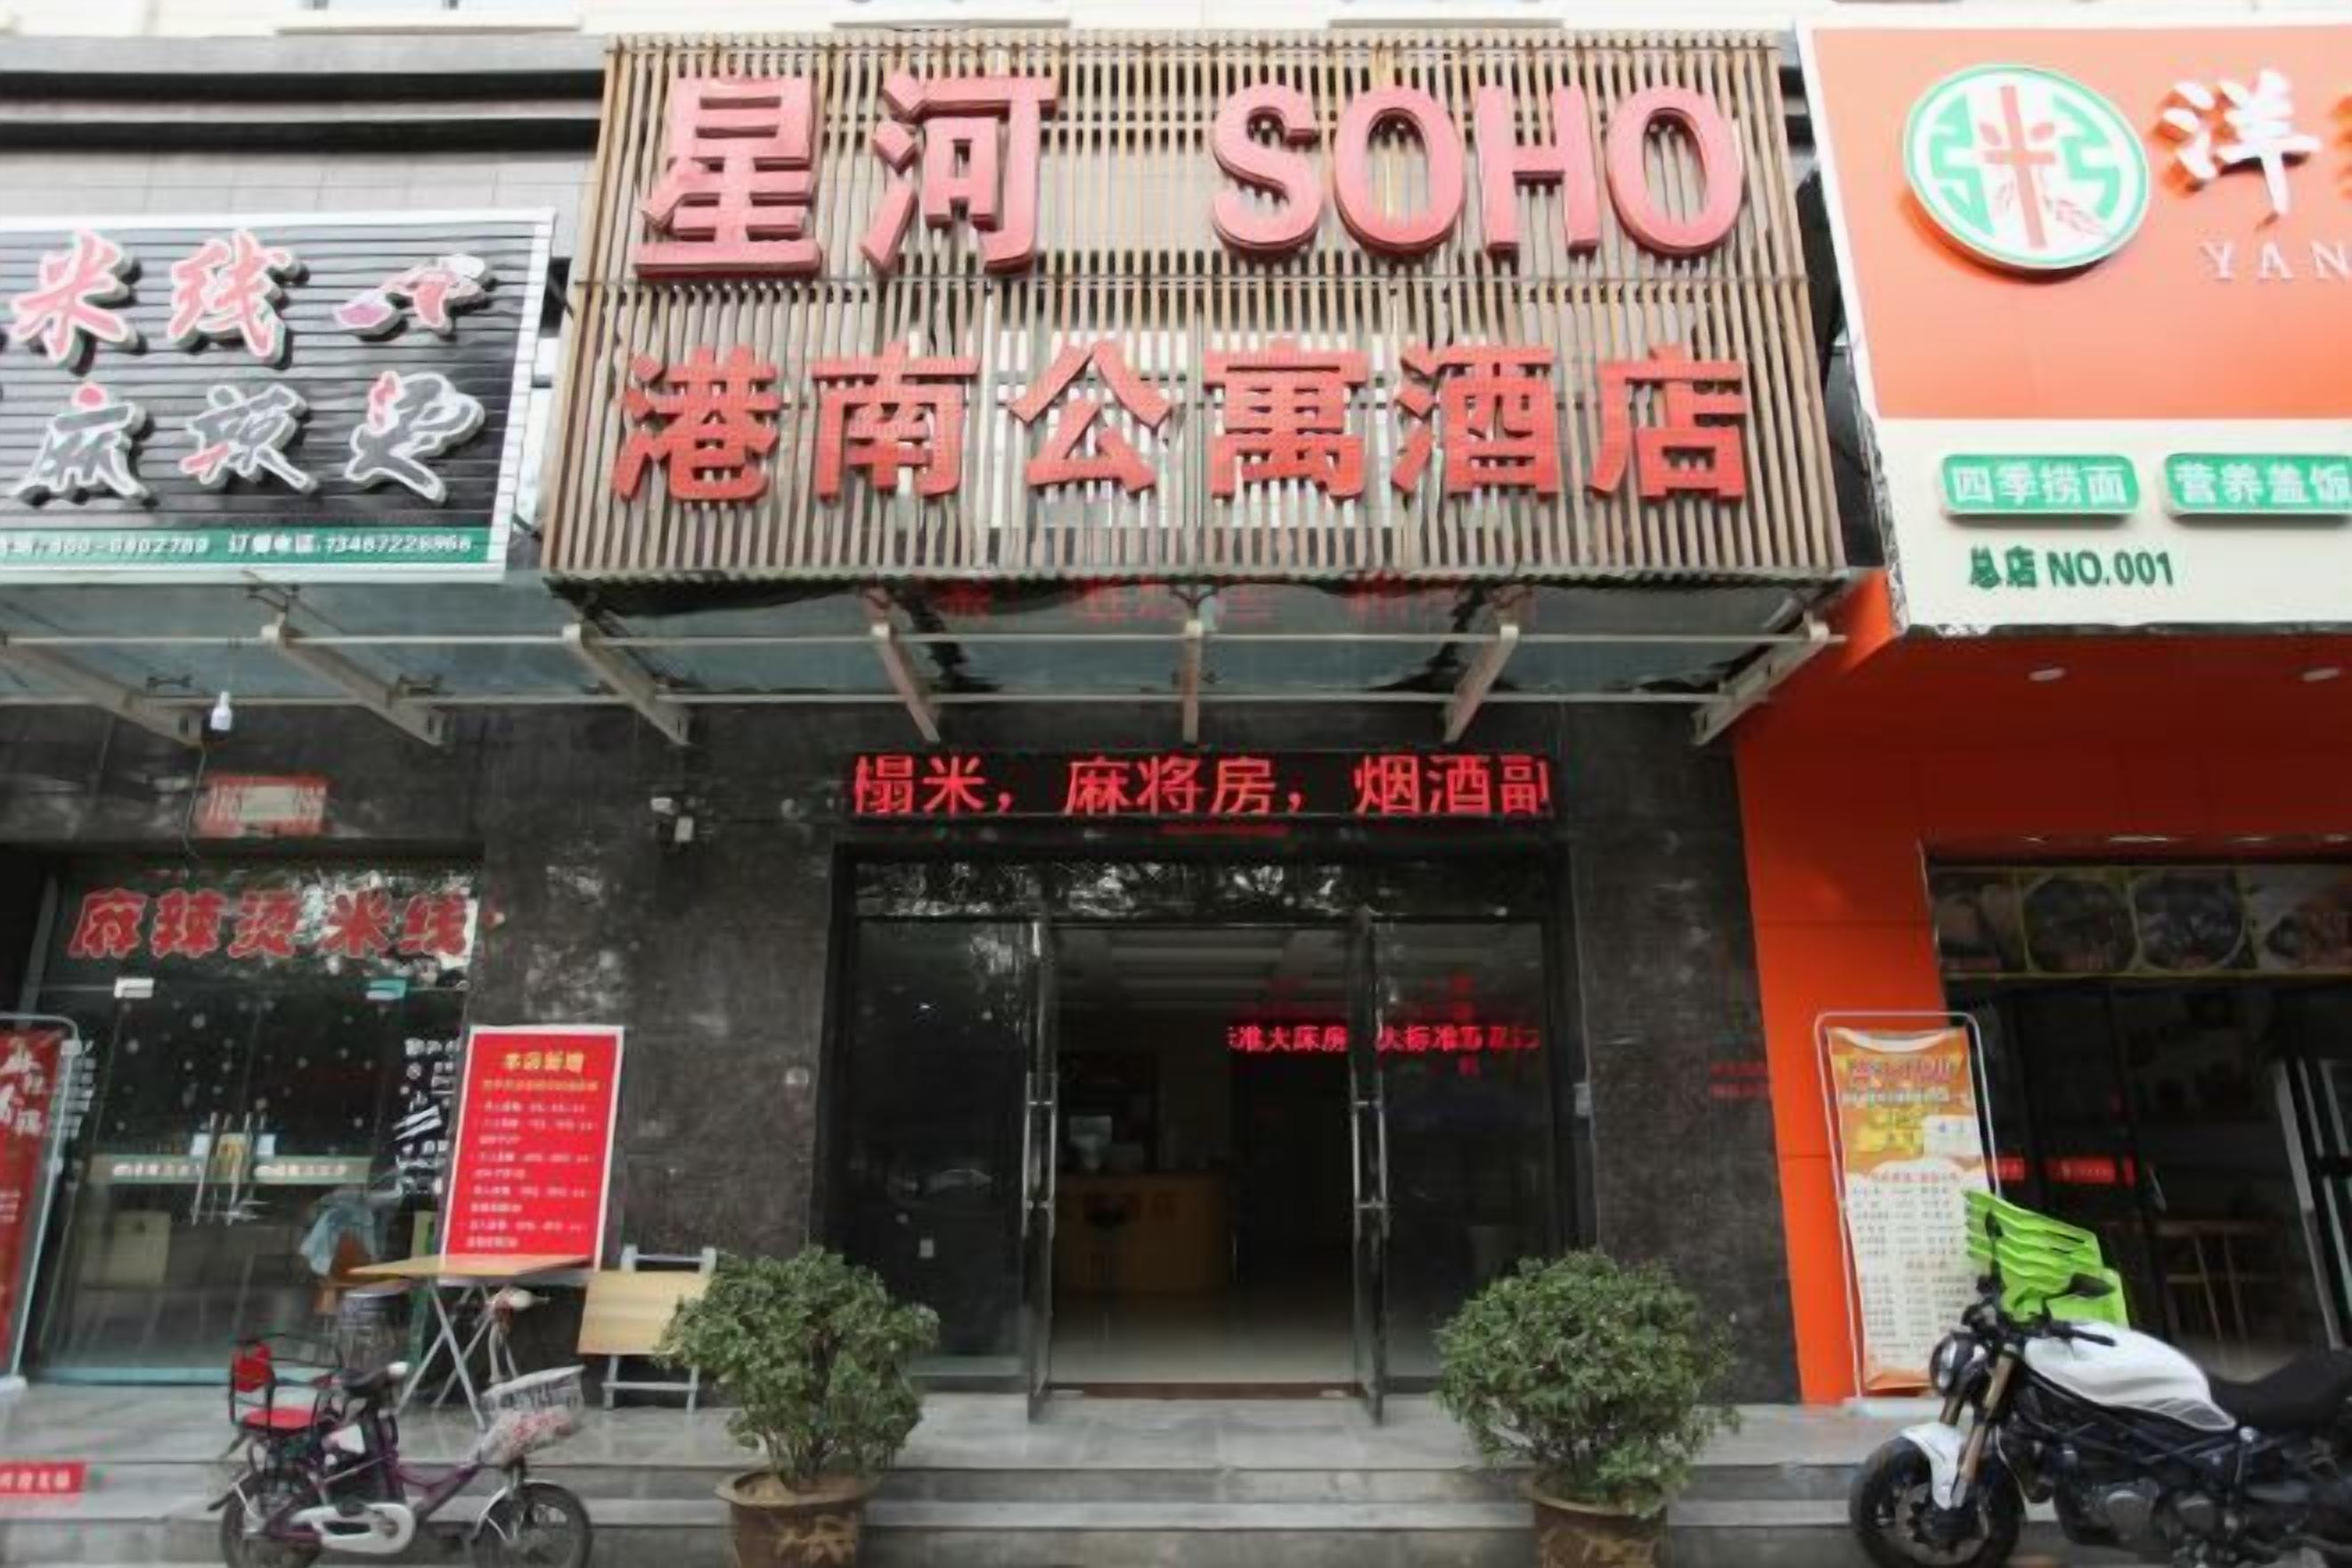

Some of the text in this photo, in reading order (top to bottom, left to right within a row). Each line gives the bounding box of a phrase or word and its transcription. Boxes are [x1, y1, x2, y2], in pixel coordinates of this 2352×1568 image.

[631, 71, 1744, 280] 星河 SOHO
[2160, 68, 2320, 219] 洋
[609, 340, 1748, 504] 港南公寓酒店
[1951, 463, 2129, 506] 四季捞面
[1970, 547, 2174, 588] 总店 NO.001
